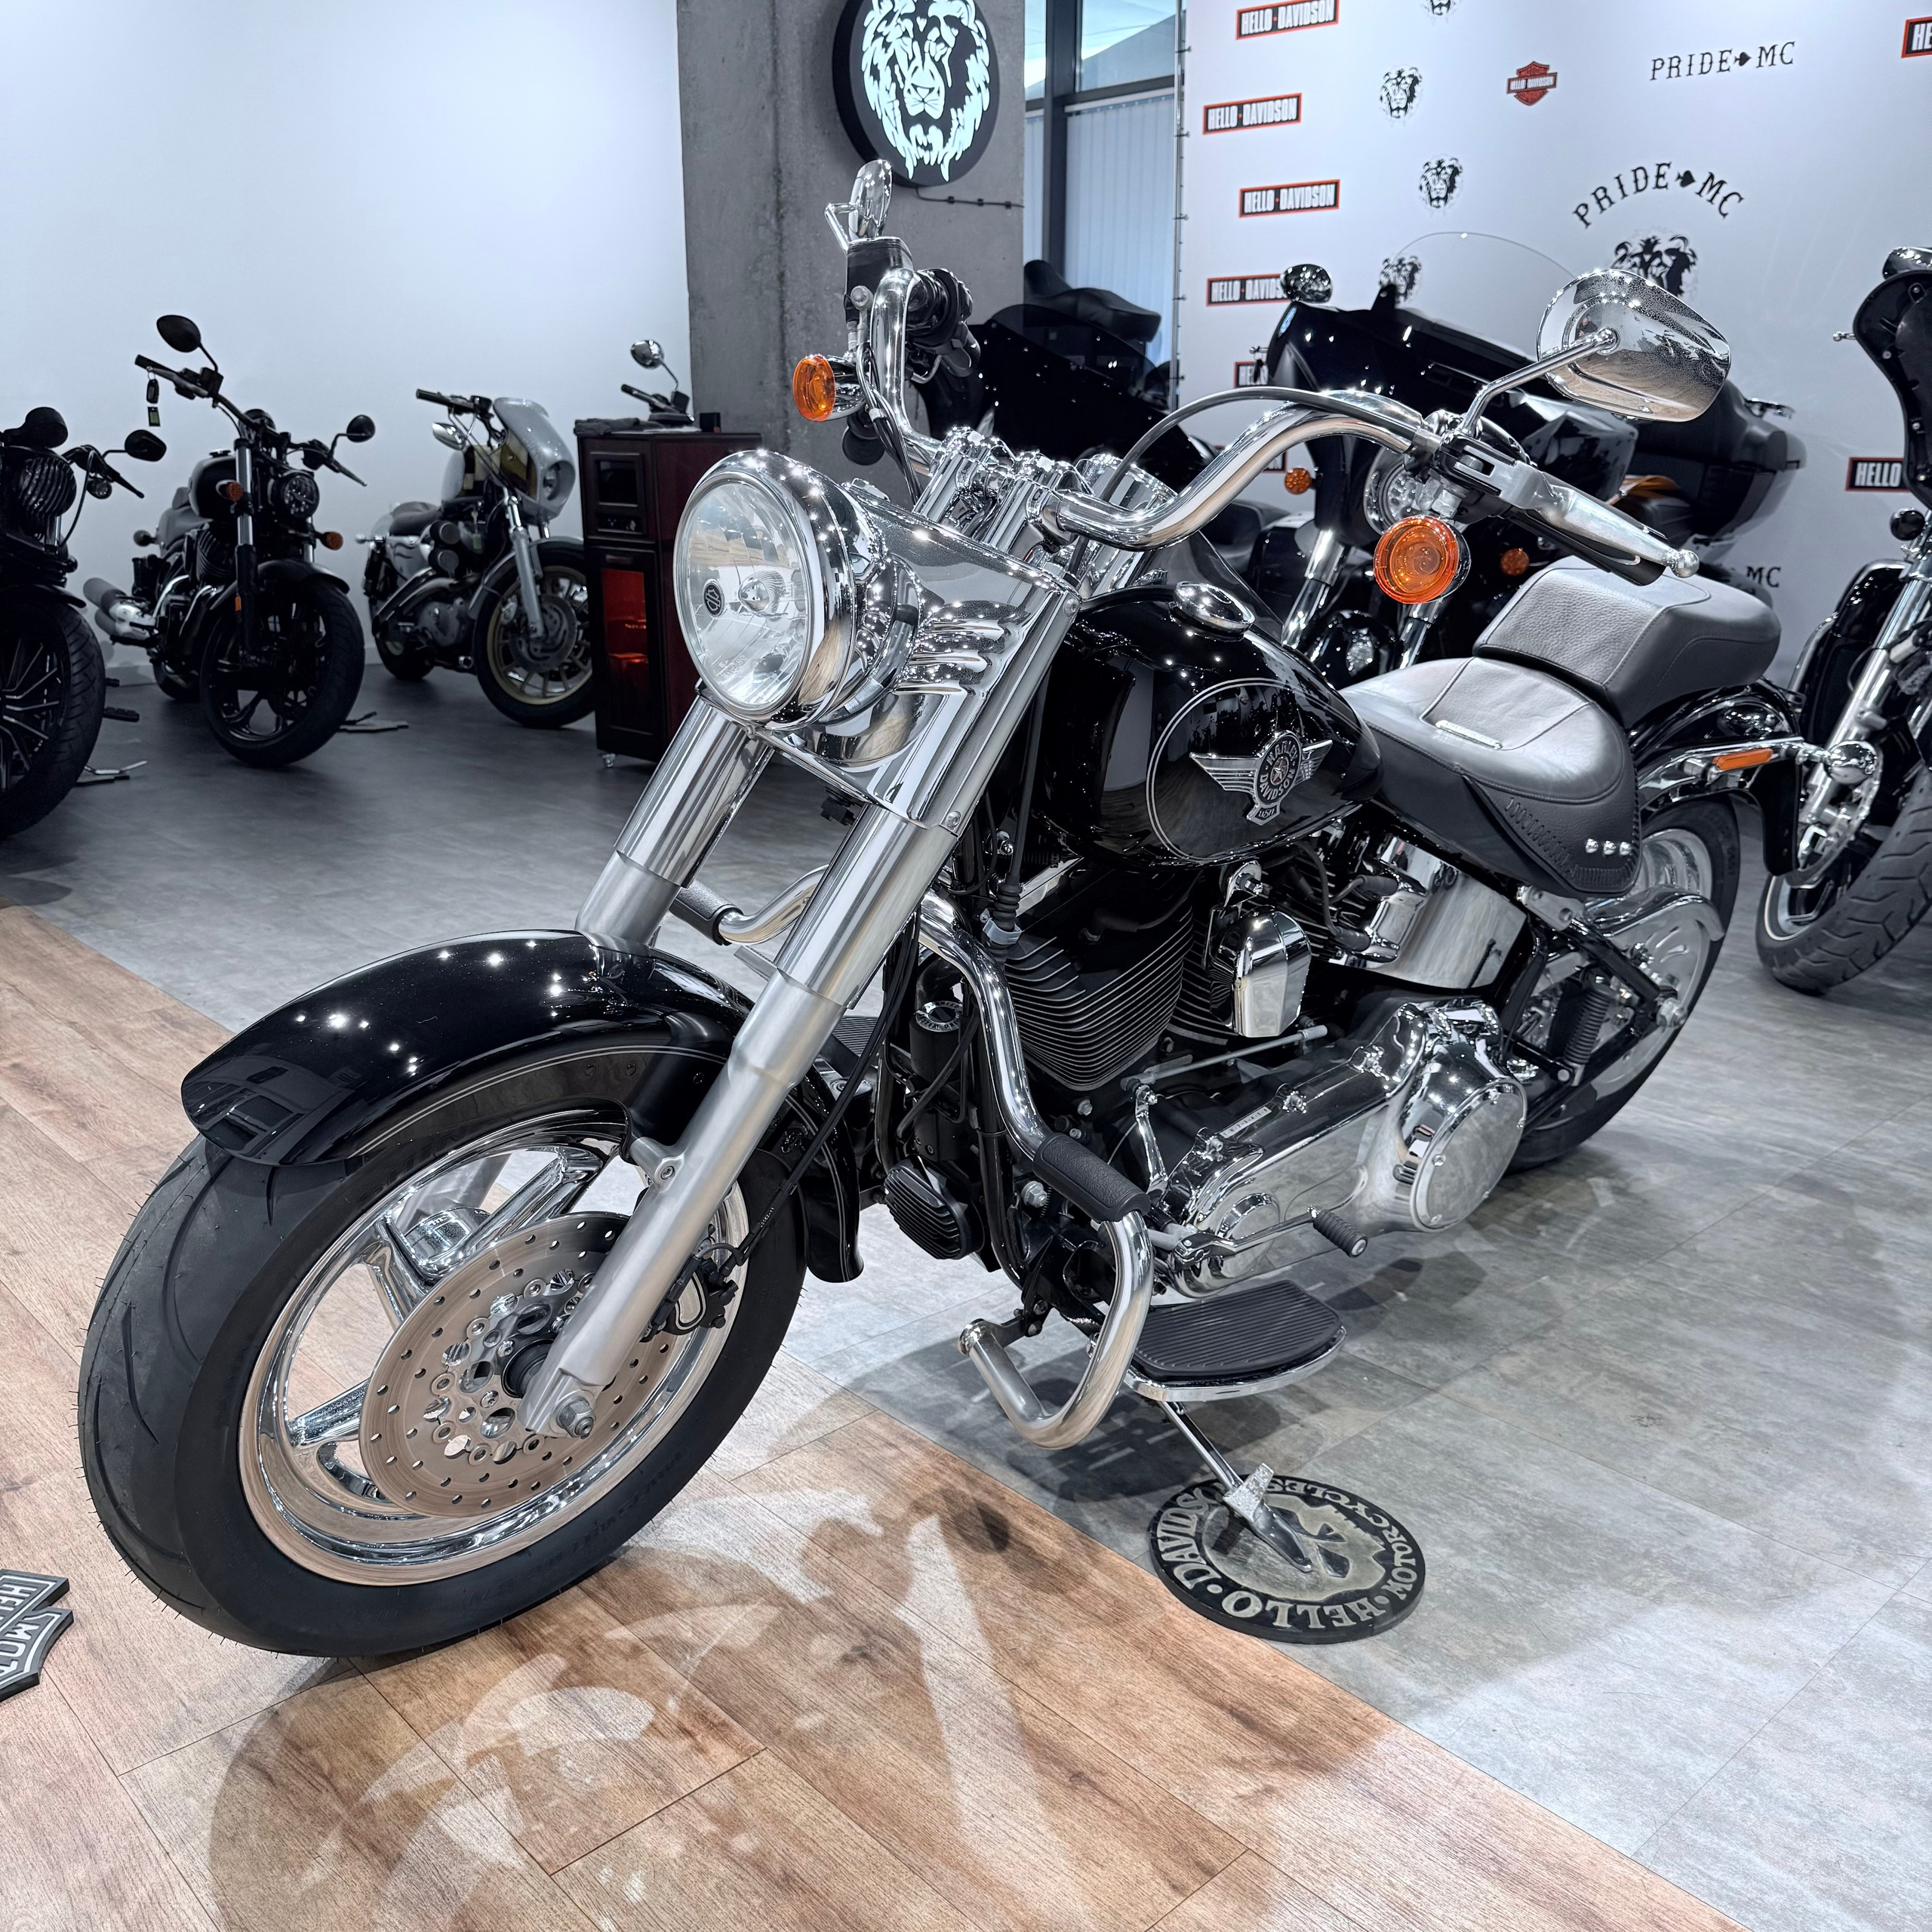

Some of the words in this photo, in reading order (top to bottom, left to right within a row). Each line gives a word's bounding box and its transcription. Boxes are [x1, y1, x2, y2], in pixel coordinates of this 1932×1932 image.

[1241, 8, 1273, 35] HELLO
[1278, 0, 1335, 29] DAVIDSON
[1651, 49, 1732, 81] PRIDE
[1756, 42, 1795, 68] MC
[1208, 105, 1238, 131] HELLO
[1242, 97, 1298, 126] DAVIDSON
[1244, 189, 1275, 214] HELLO
[1279, 183, 1336, 211] DAVIDSON
[1573, 162, 1672, 229] PRIDE
[1695, 172, 1744, 219] MC
[1211, 279, 1241, 302] HELLO
[1245, 278, 1287, 300] DAVIDS
[1855, 462, 1902, 487] HELLO
[1747, 567, 1780, 587] MC
[1221, 1590, 1386, 1629] HELLO
